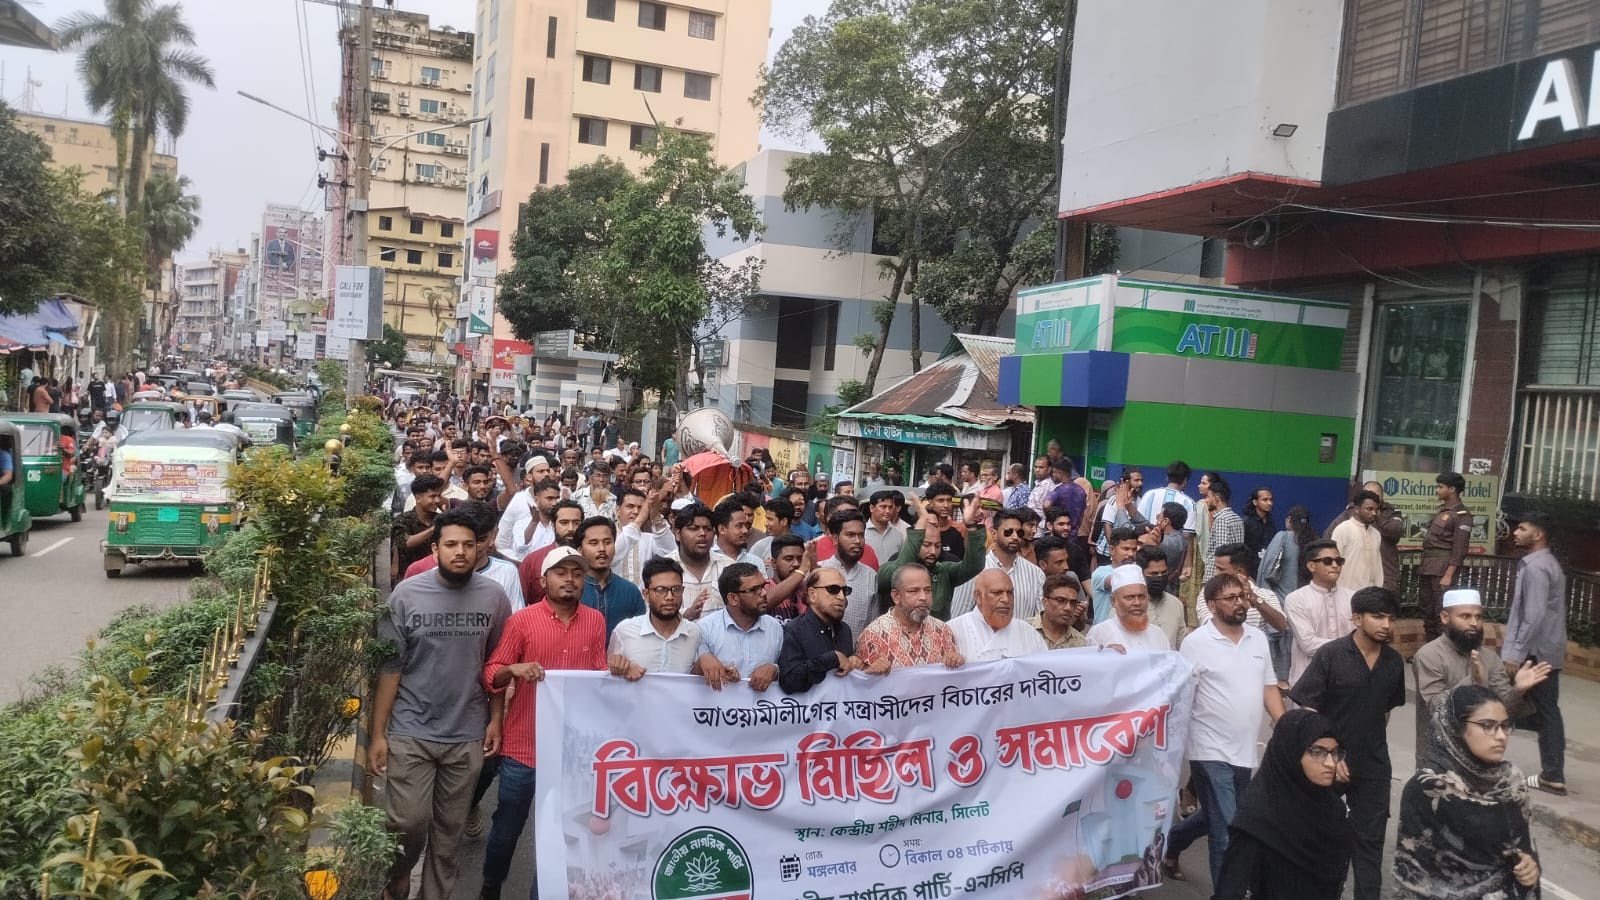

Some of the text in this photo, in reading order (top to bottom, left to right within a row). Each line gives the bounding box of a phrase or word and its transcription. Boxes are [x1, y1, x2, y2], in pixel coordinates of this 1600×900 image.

[1517, 50, 1600, 141] A
[1401, 478, 1437, 496] Richm
[412, 612, 492, 628] BURBERRY
[693, 670, 1082, 728] আওয়ামীলীগের সন্ত্রাসীদের বিচারের দাবীতে
[591, 703, 1173, 819] বিক্ষোভ মিছিল ও সমাবেশ
[952, 801, 990, 820] সিলেট
[689, 833, 726, 851] নাগরিক
[904, 840, 1014, 866] বিকাল ০৪ ঘটিকায়
[806, 860, 857, 878] মঙ্গলবার
